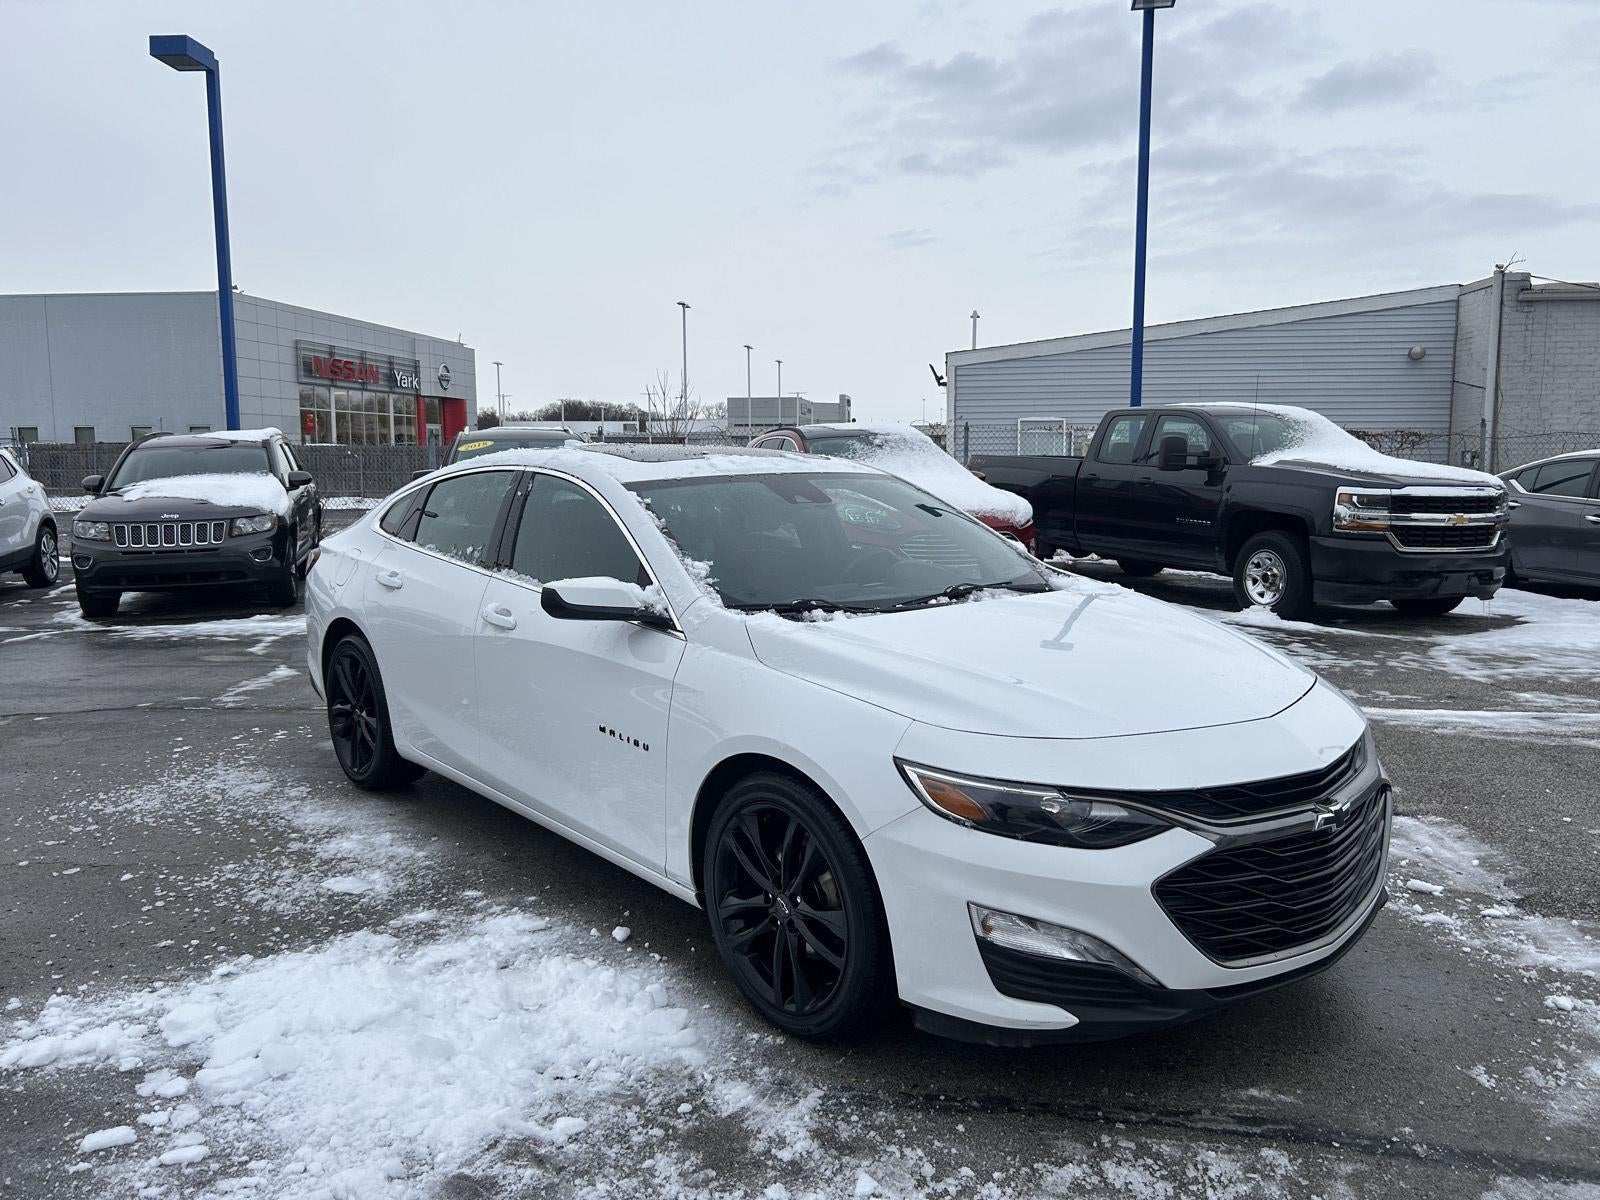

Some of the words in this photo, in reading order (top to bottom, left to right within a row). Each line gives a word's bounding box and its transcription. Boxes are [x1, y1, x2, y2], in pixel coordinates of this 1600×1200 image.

[312, 355, 380, 384] NISSAN
[393, 369, 419, 389] Yark
[599, 724, 649, 751] MALIBU
